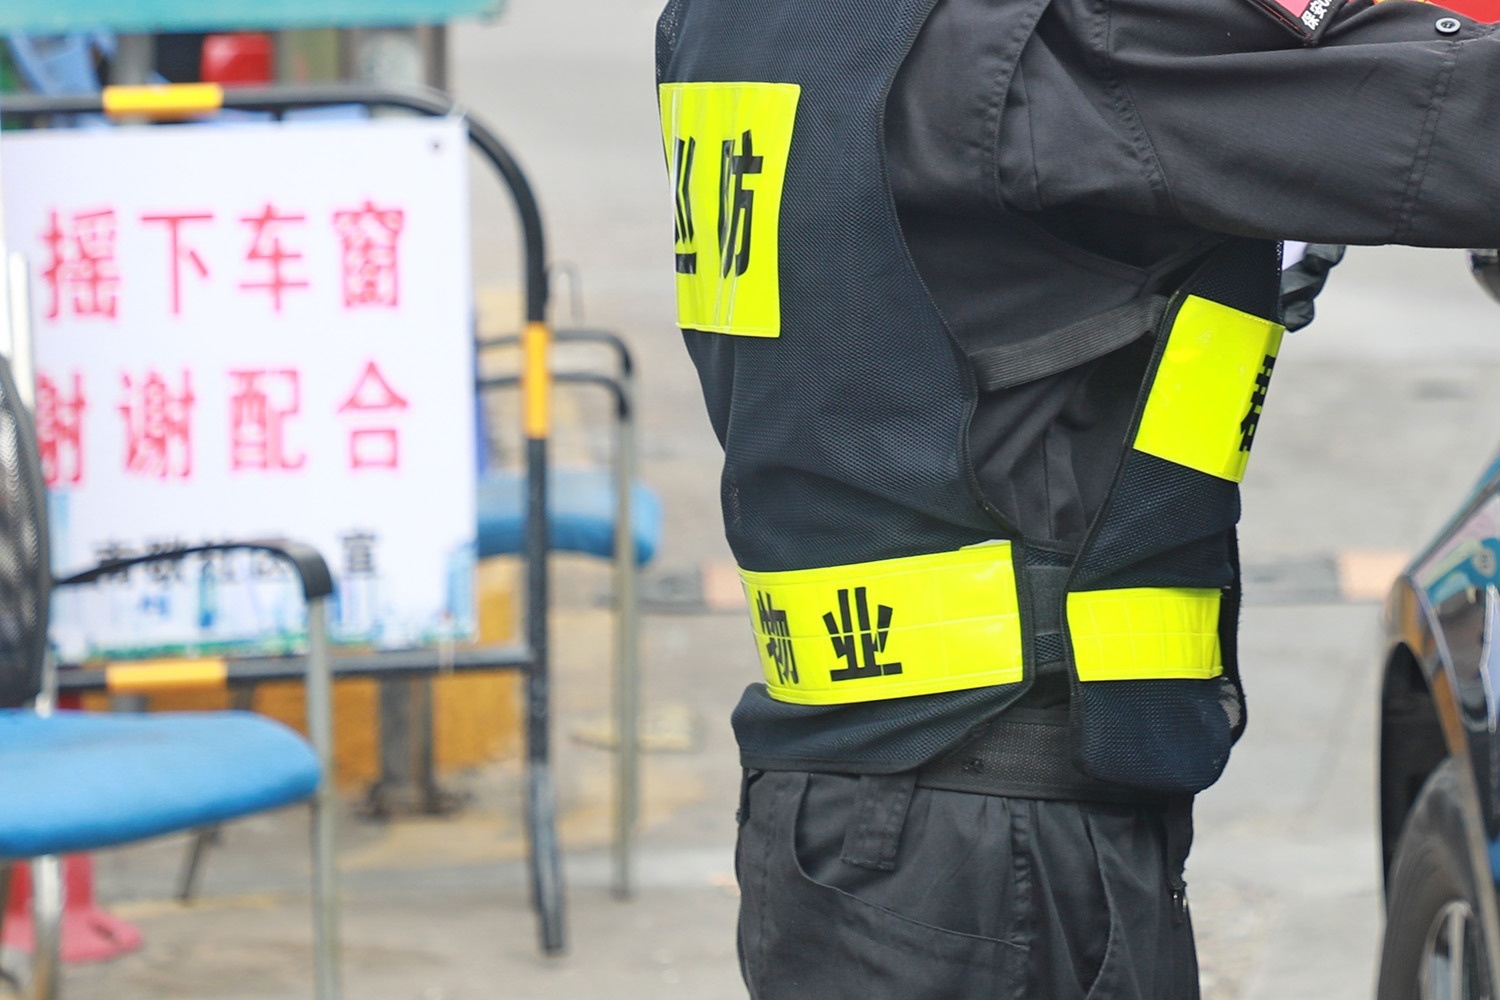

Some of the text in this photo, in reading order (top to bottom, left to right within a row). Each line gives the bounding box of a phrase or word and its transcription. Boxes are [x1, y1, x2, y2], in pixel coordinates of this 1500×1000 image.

[40, 200, 406, 320] 摇下车窗
[755, 586, 904, 686] 物业
